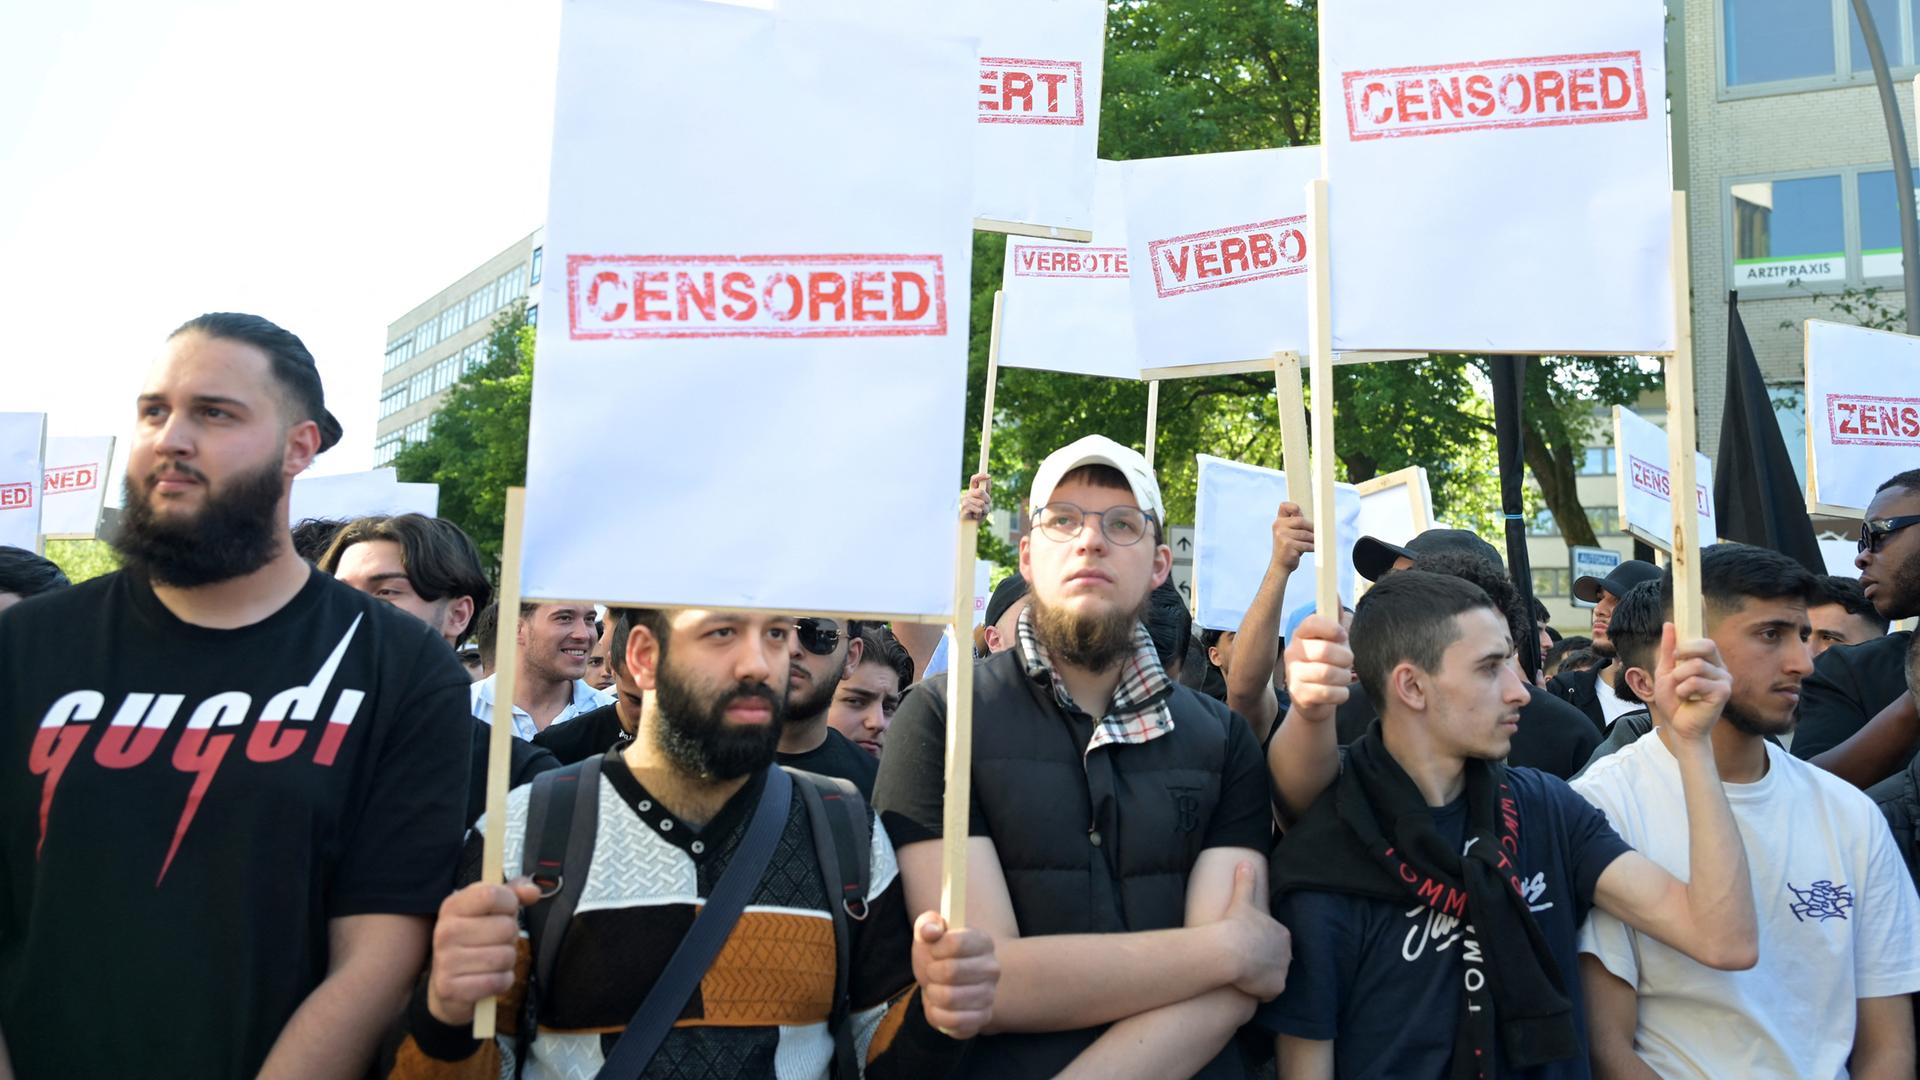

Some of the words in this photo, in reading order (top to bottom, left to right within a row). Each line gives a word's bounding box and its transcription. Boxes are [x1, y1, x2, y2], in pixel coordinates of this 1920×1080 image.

[1360, 66, 1633, 125] CENSORED
[1021, 250, 1129, 274] VERBOTE
[1163, 228, 1308, 283] VERBO
[1747, 262, 1832, 279] ARZTPRAXIS
[586, 270, 932, 322] CENSORED
[1633, 462, 1704, 509] ZENST
[1384, 847, 1469, 918] OMM
